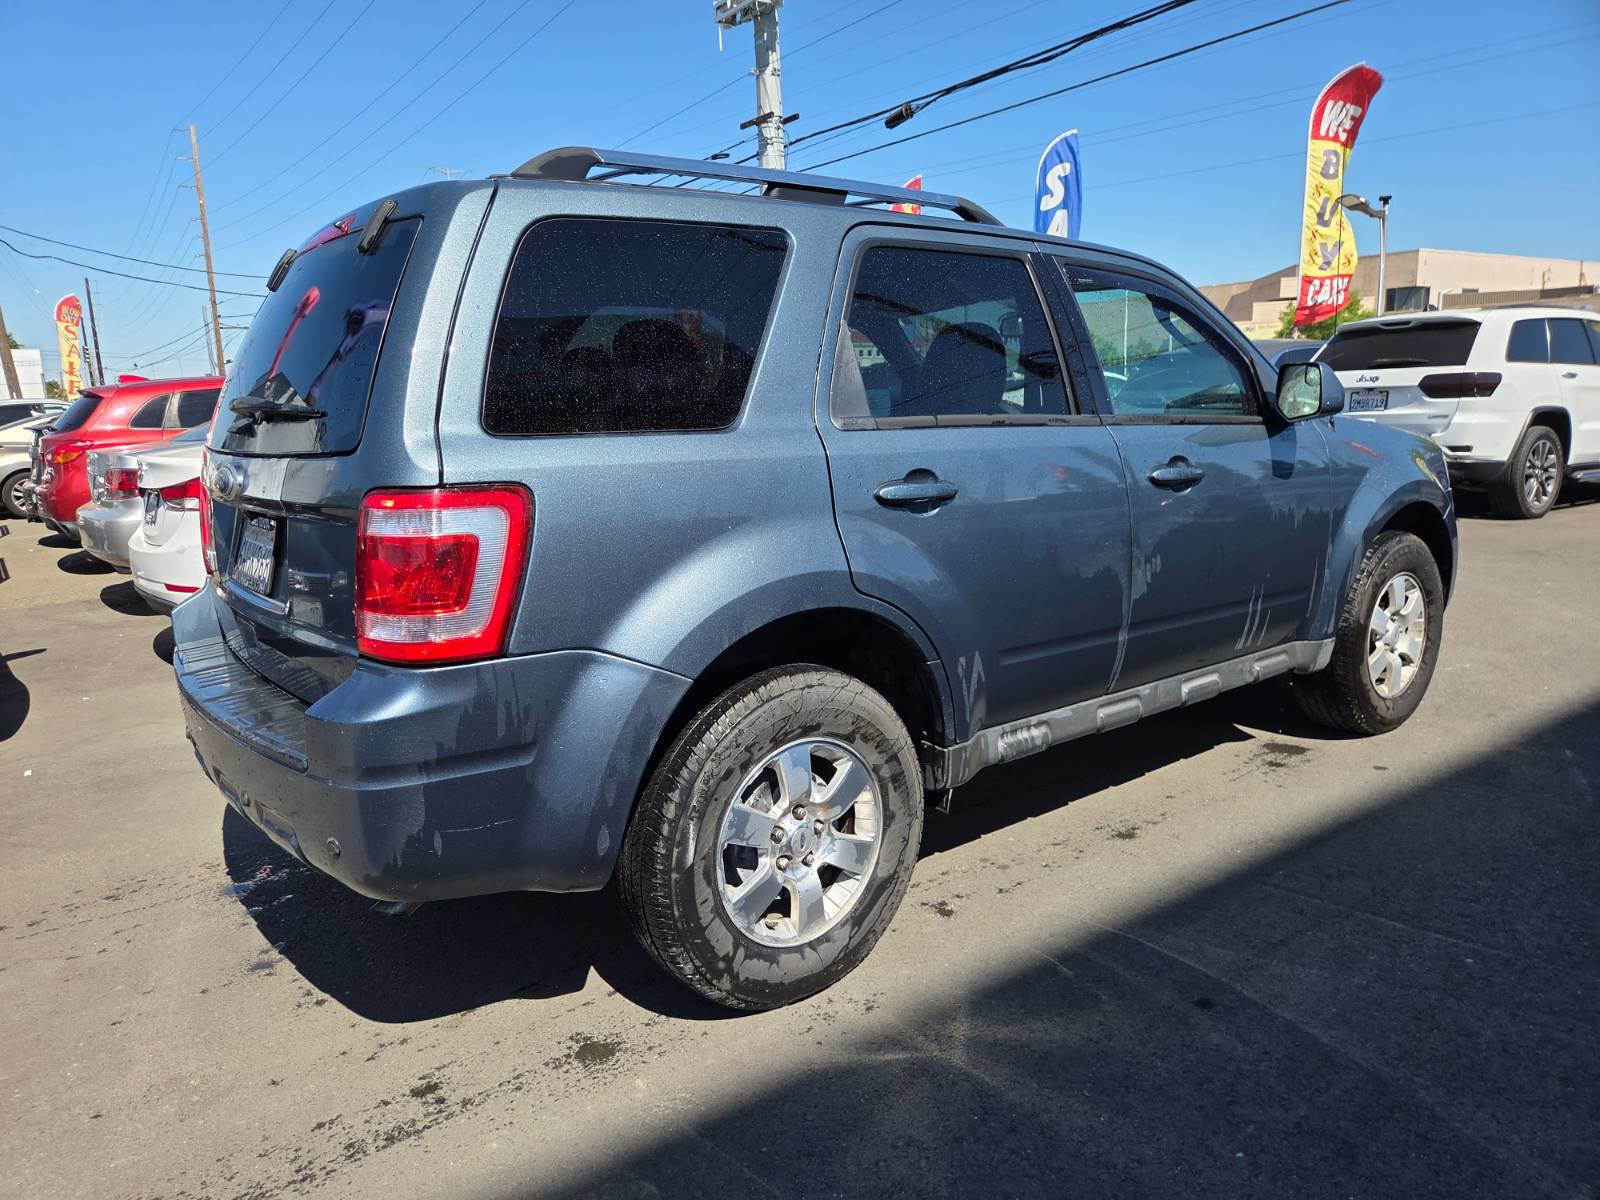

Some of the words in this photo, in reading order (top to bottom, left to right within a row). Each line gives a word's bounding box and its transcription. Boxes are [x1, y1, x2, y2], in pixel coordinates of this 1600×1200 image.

[1320, 99, 1363, 143] WE
[1316, 149, 1344, 271] BUY
[61, 313, 77, 325] OUT
[62, 305, 80, 318] BLOW
